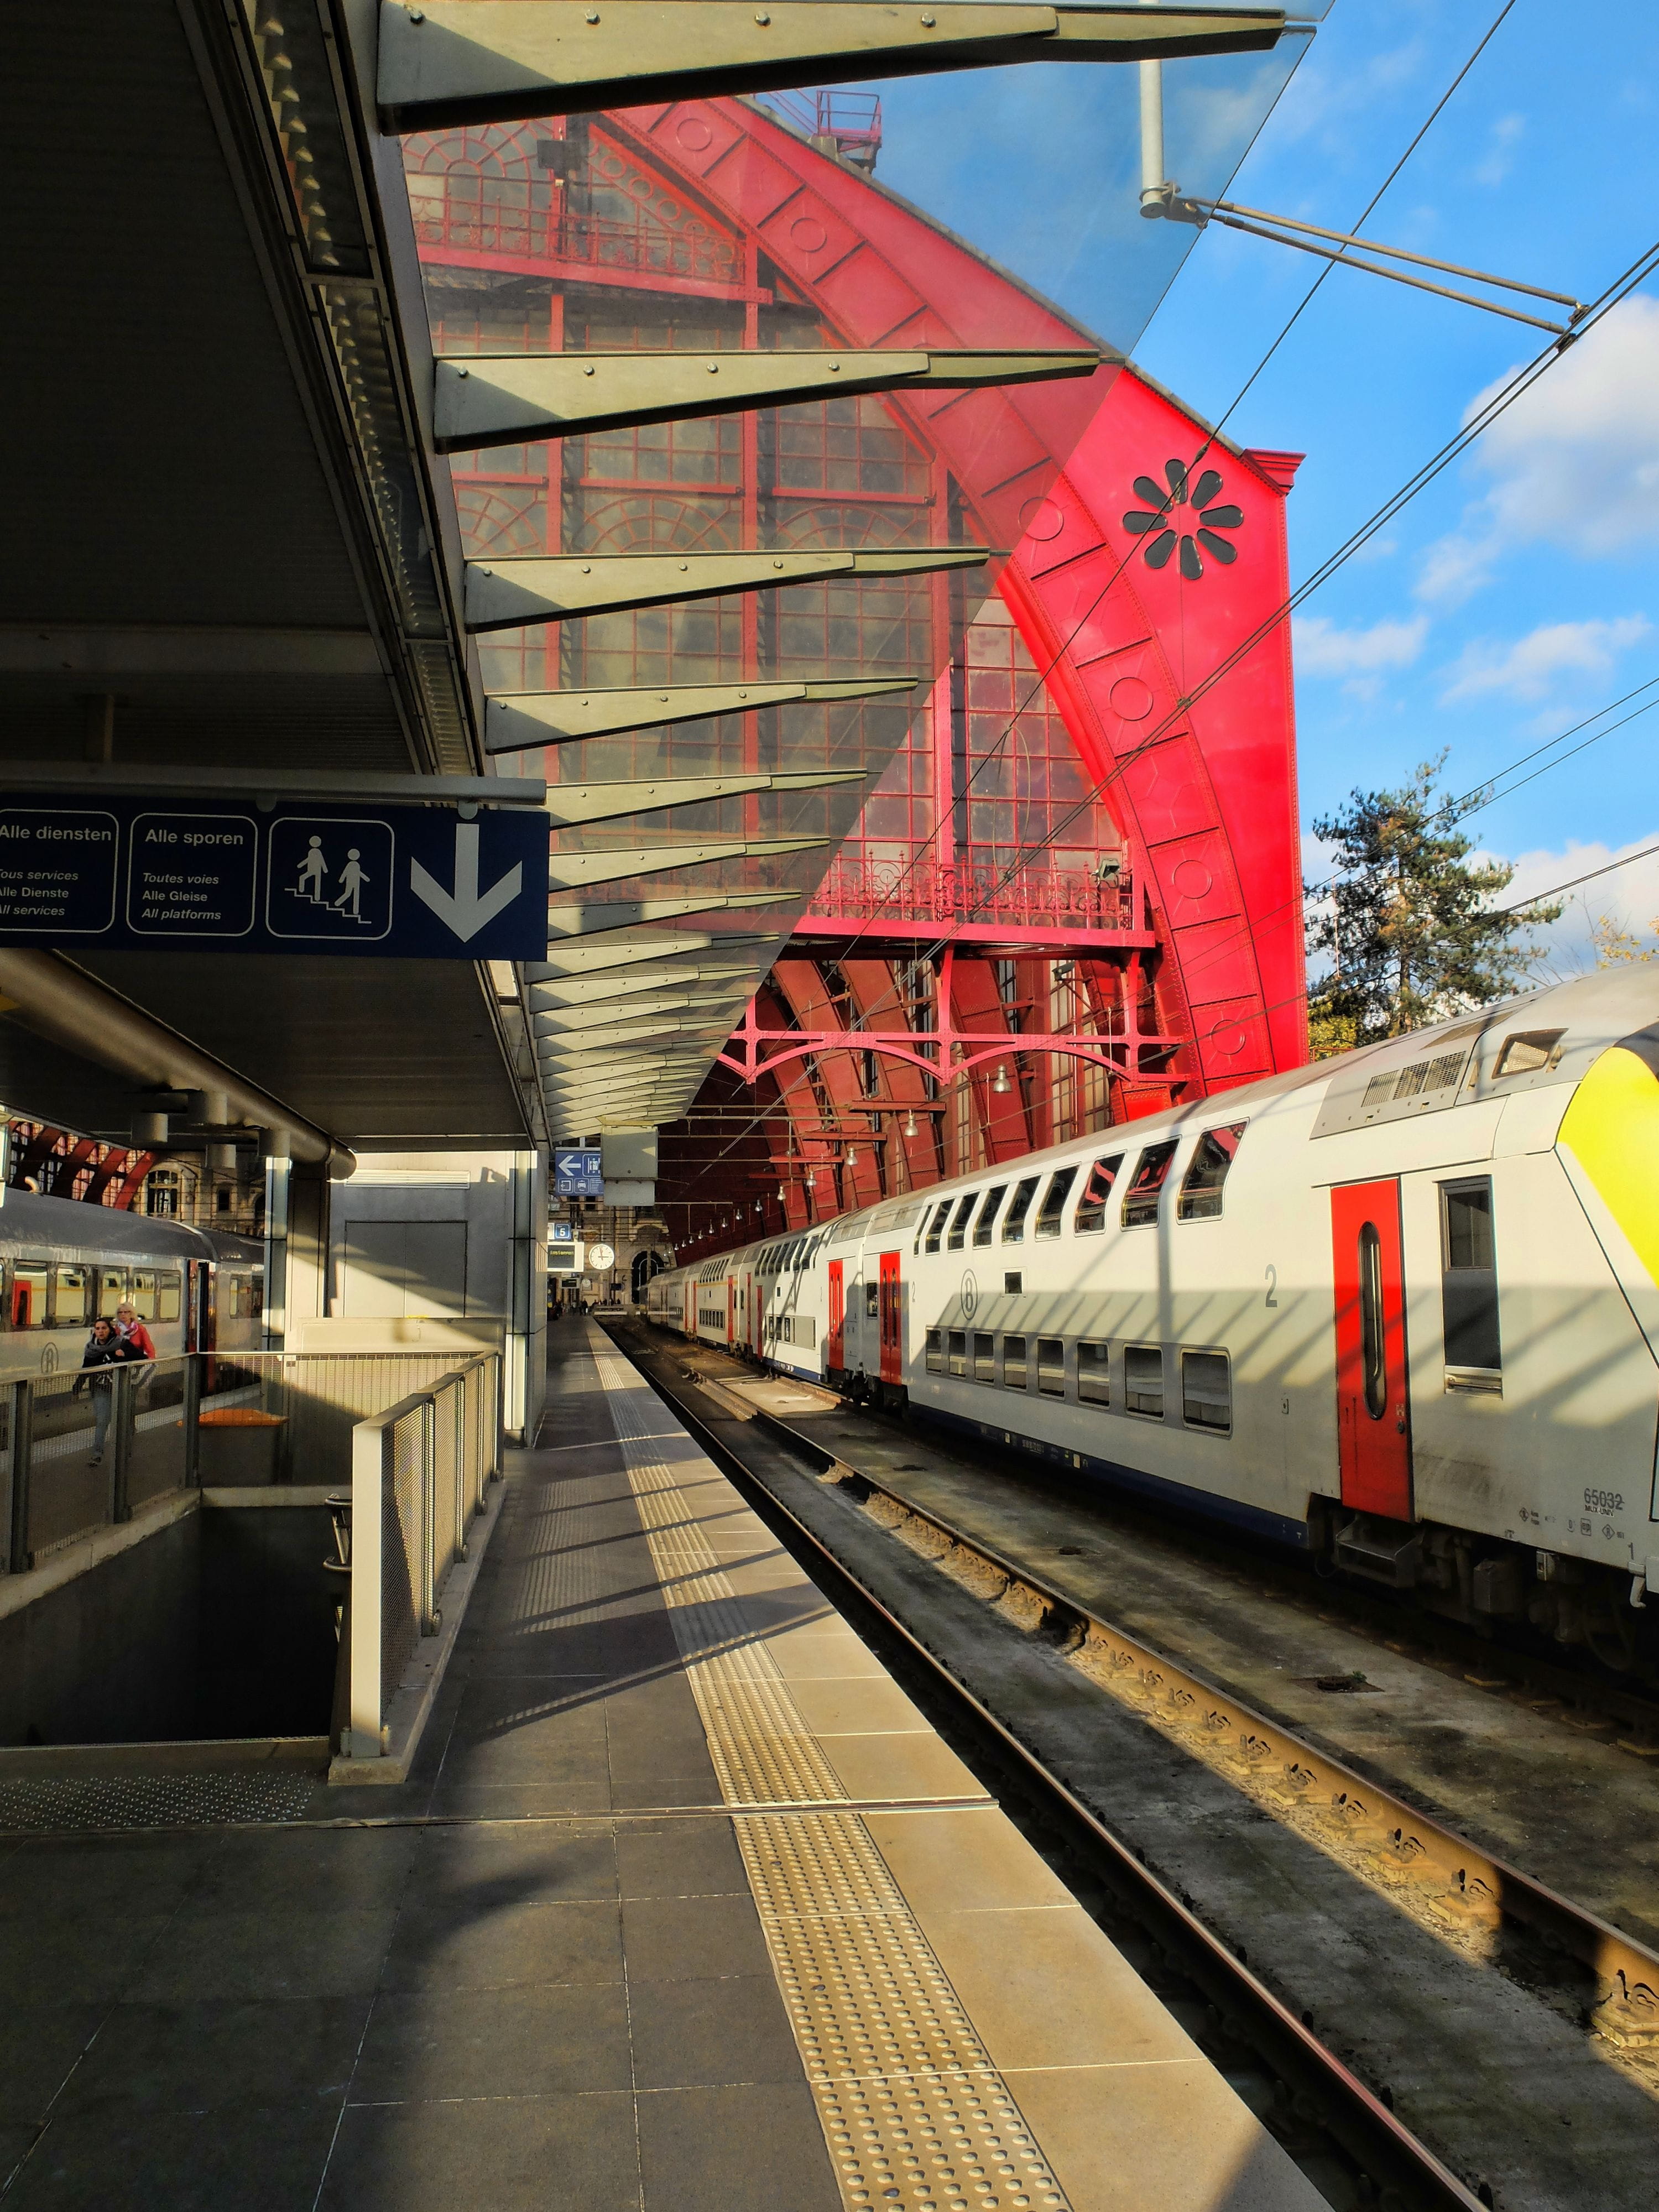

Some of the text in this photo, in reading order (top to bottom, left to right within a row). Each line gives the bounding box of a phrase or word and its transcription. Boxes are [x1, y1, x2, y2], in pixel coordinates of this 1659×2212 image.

[0, 825, 111, 841] Alle diensten
[145, 829, 243, 846] Alle sporen
[27, 870, 79, 880] services
[143, 872, 219, 884] Toutes voies
[22, 887, 69, 898] Dienste
[142, 890, 208, 901] Alle Gleise
[13, 905, 65, 916] services
[142, 908, 222, 920] All platforms
[560, 1228, 566, 1237] 5
[1265, 1264, 1277, 1307] 2
[1584, 1488, 1624, 1510] 65032
[1585, 1505, 1614, 1517] MUX-UNIV
